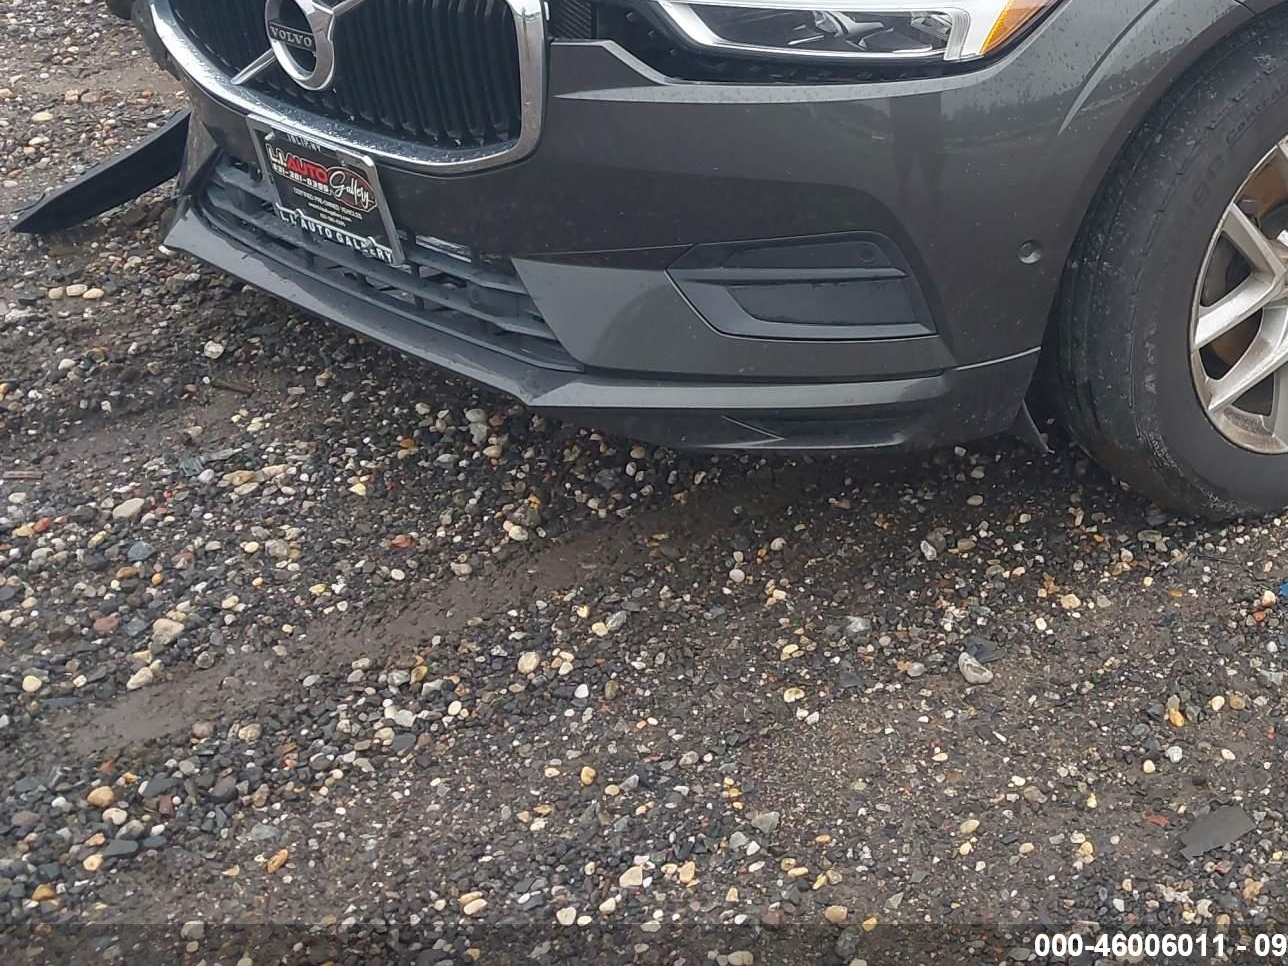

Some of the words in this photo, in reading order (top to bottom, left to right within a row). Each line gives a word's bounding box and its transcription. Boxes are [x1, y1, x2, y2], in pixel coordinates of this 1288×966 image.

[269, 25, 313, 48] VOLVO
[287, 155, 329, 185] AUTO
[329, 170, 375, 210] Gallery
[300, 217, 333, 239] AUTO
